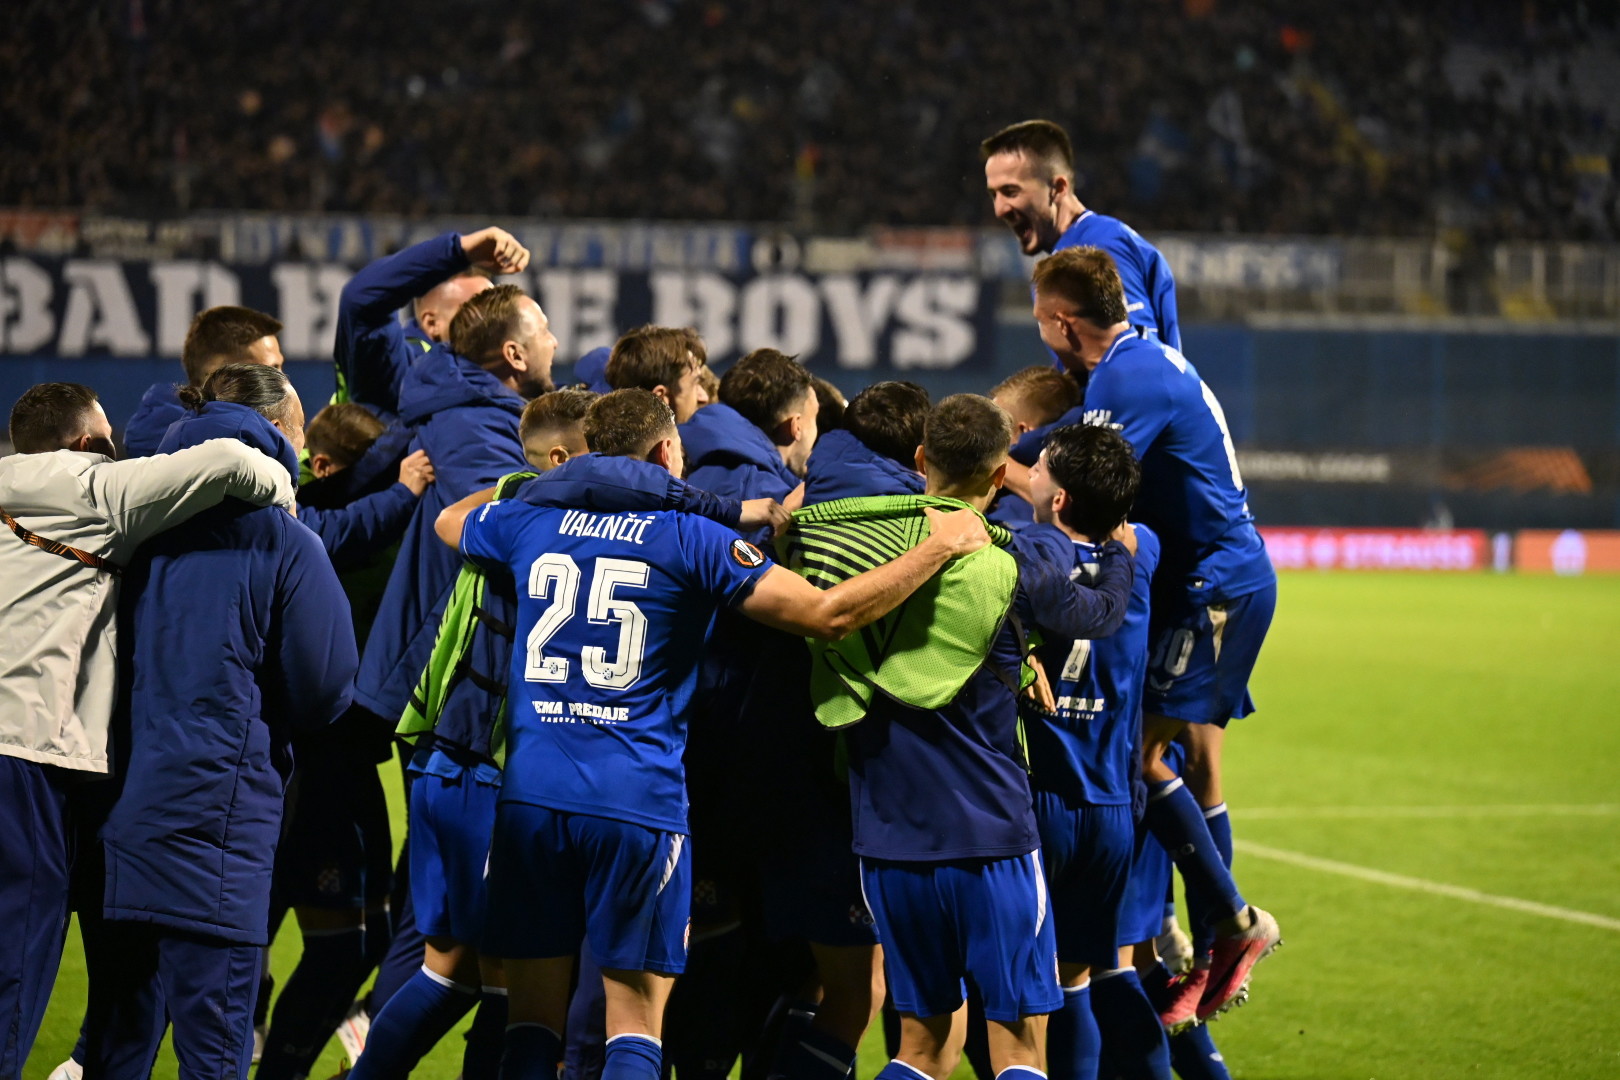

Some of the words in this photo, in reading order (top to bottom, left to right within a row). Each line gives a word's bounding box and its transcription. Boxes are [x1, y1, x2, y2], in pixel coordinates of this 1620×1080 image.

[649, 270, 979, 370] BOYS
[558, 509, 656, 545] VALINČIĆ
[524, 552, 651, 691] 25
[532, 701, 563, 715] EMA
[568, 702, 629, 721] PREDAJE
